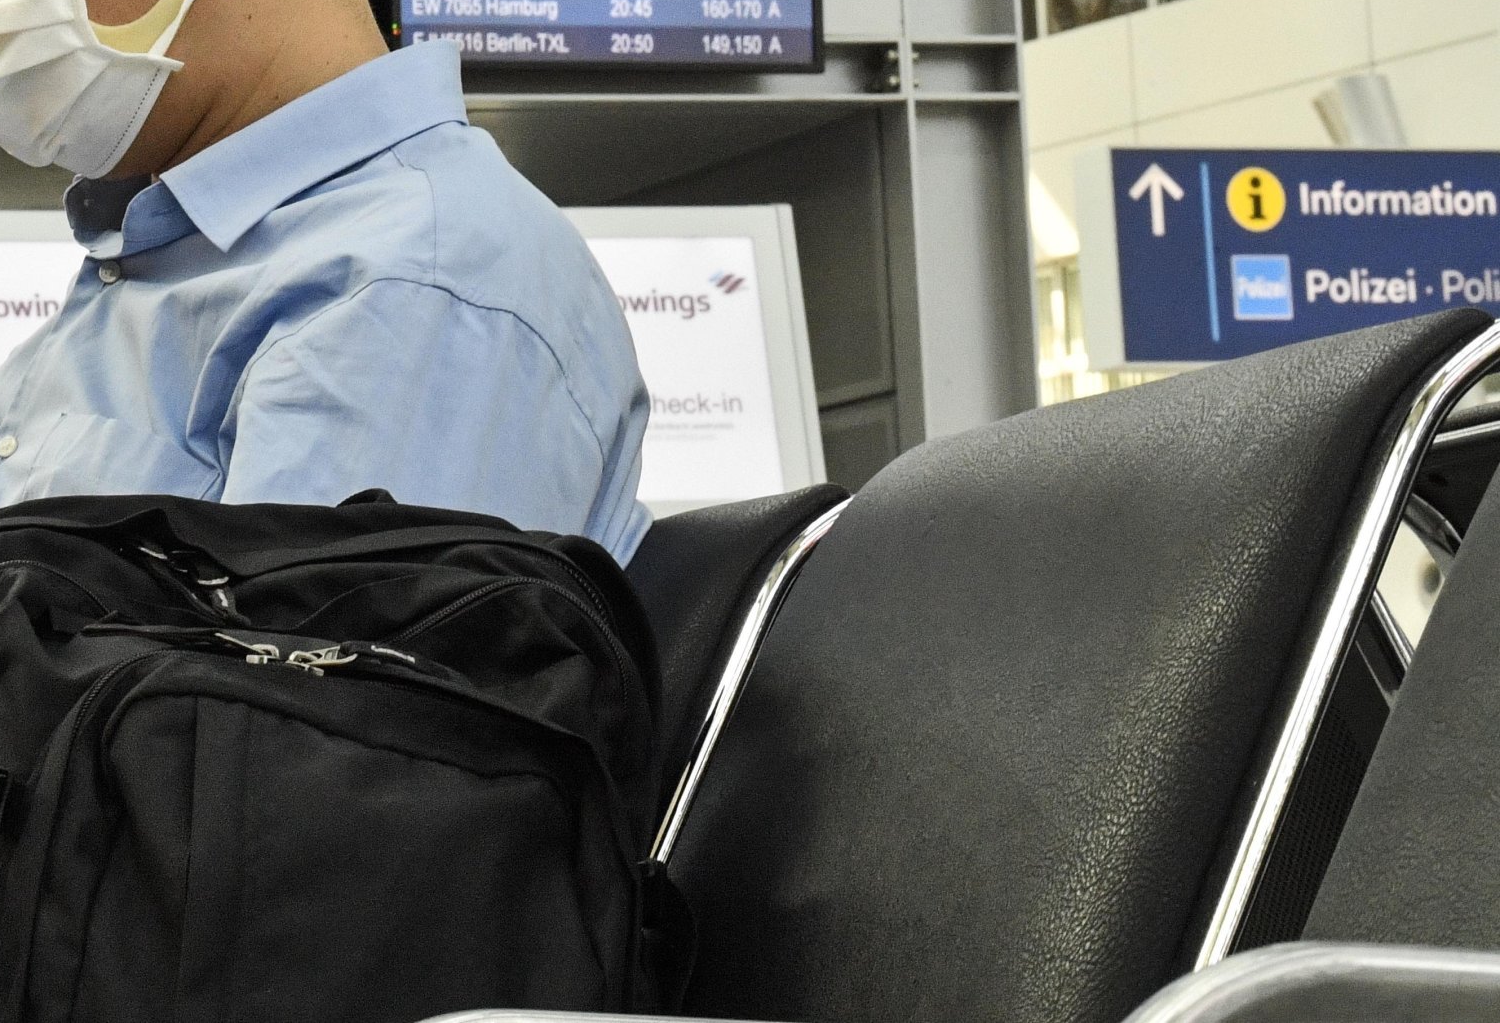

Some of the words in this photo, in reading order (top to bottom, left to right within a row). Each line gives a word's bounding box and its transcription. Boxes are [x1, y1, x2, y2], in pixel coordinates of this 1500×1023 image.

[1299, 181, 1496, 216] Information
[1237, 279, 1285, 299] Polizei
[1306, 269, 1416, 304] Polizei
